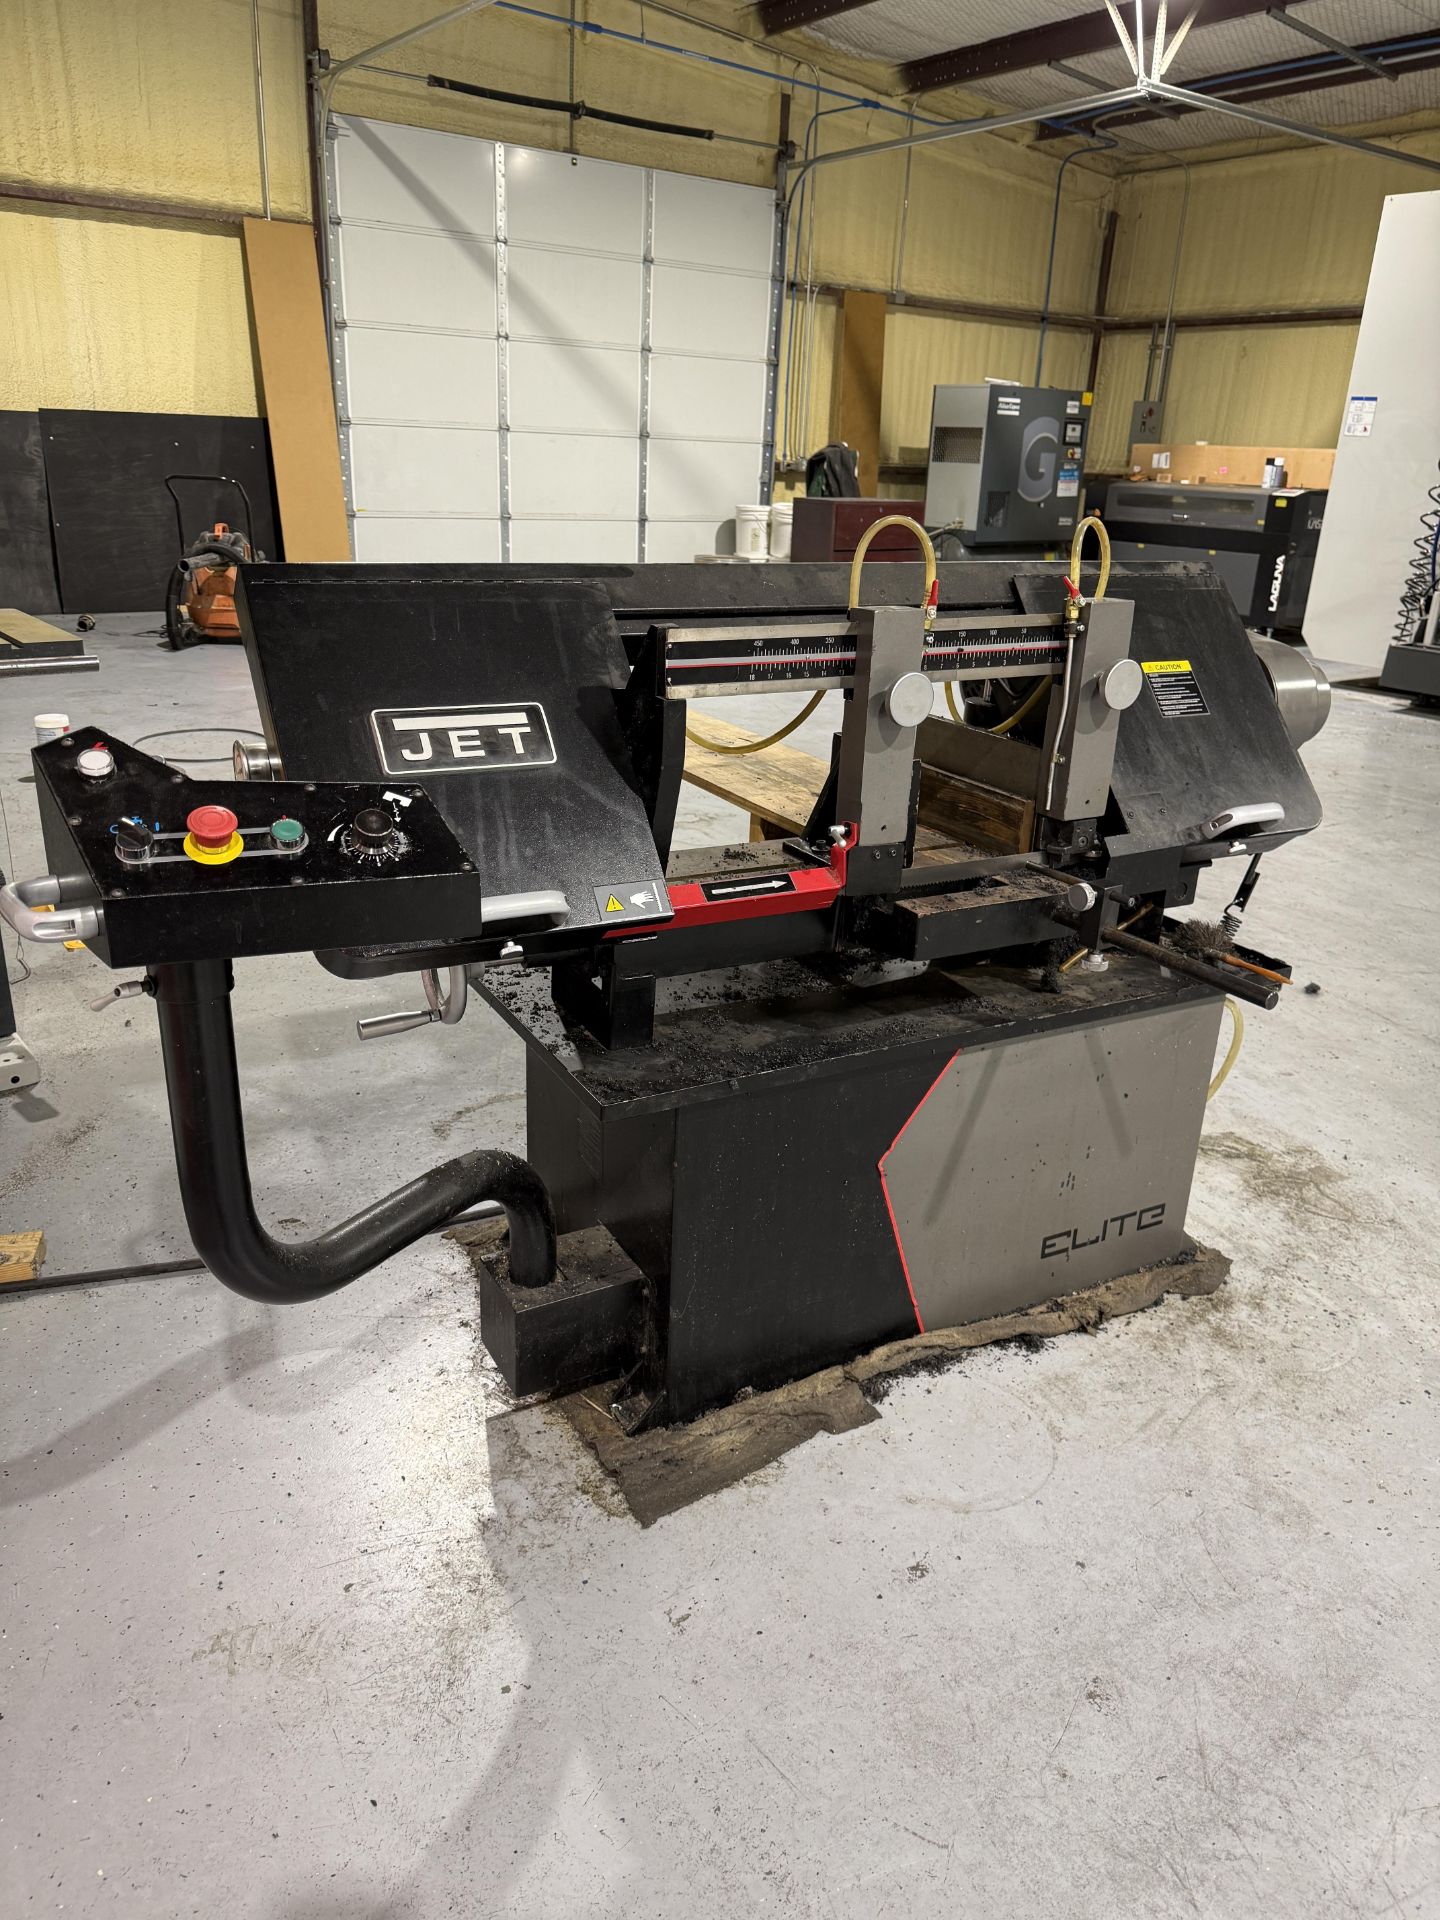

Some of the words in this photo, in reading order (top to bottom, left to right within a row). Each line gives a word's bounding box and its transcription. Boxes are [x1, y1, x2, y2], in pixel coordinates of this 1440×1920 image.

[1018, 416, 1060, 502] G
[1268, 554, 1286, 612] LAGUNA
[1154, 663, 1182, 671] CAUTION
[401, 726, 532, 761] JET
[1040, 1203, 1166, 1259] ELITE
